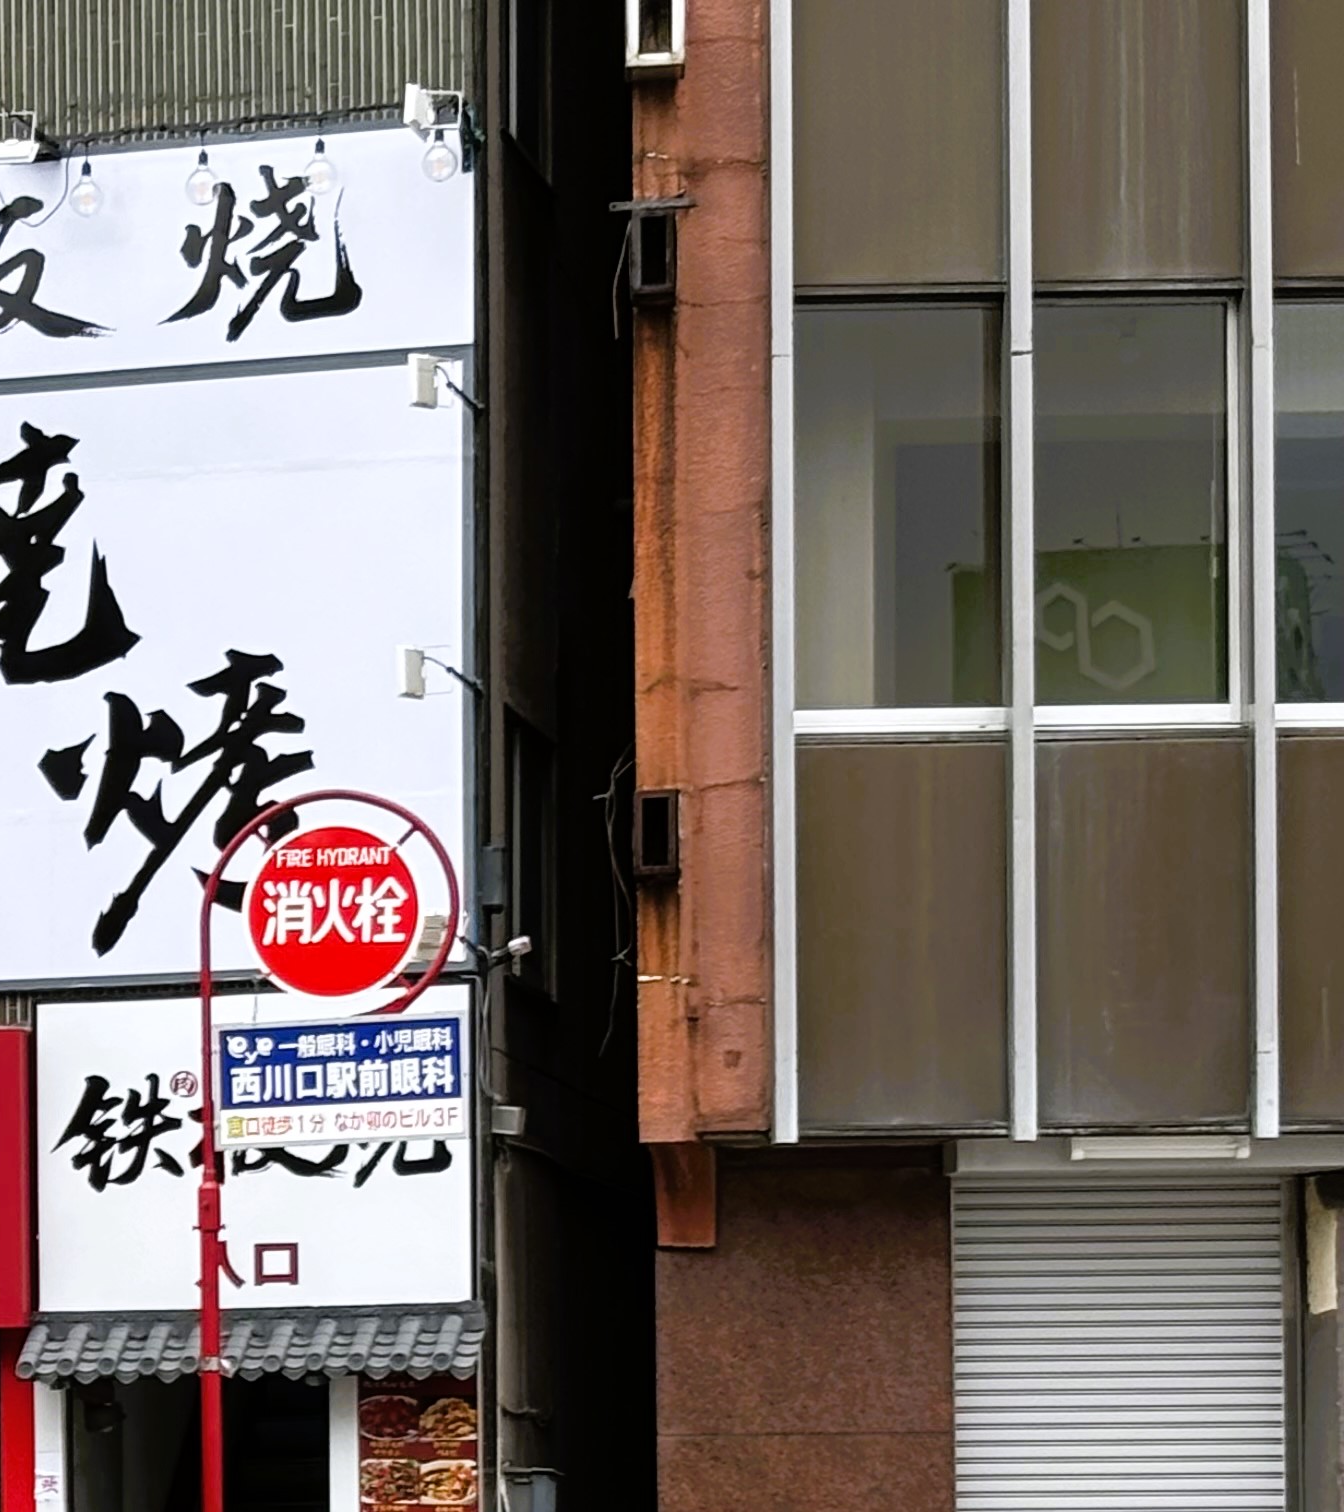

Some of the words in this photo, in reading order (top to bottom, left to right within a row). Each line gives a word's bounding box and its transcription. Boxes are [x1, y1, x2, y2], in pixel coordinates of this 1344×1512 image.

[275, 848, 313, 868] FIRE
[316, 846, 392, 866] HYDRANT
[262, 876, 409, 946] 消火栓
[230, 1055, 454, 1104] 西川口駅前眼科
